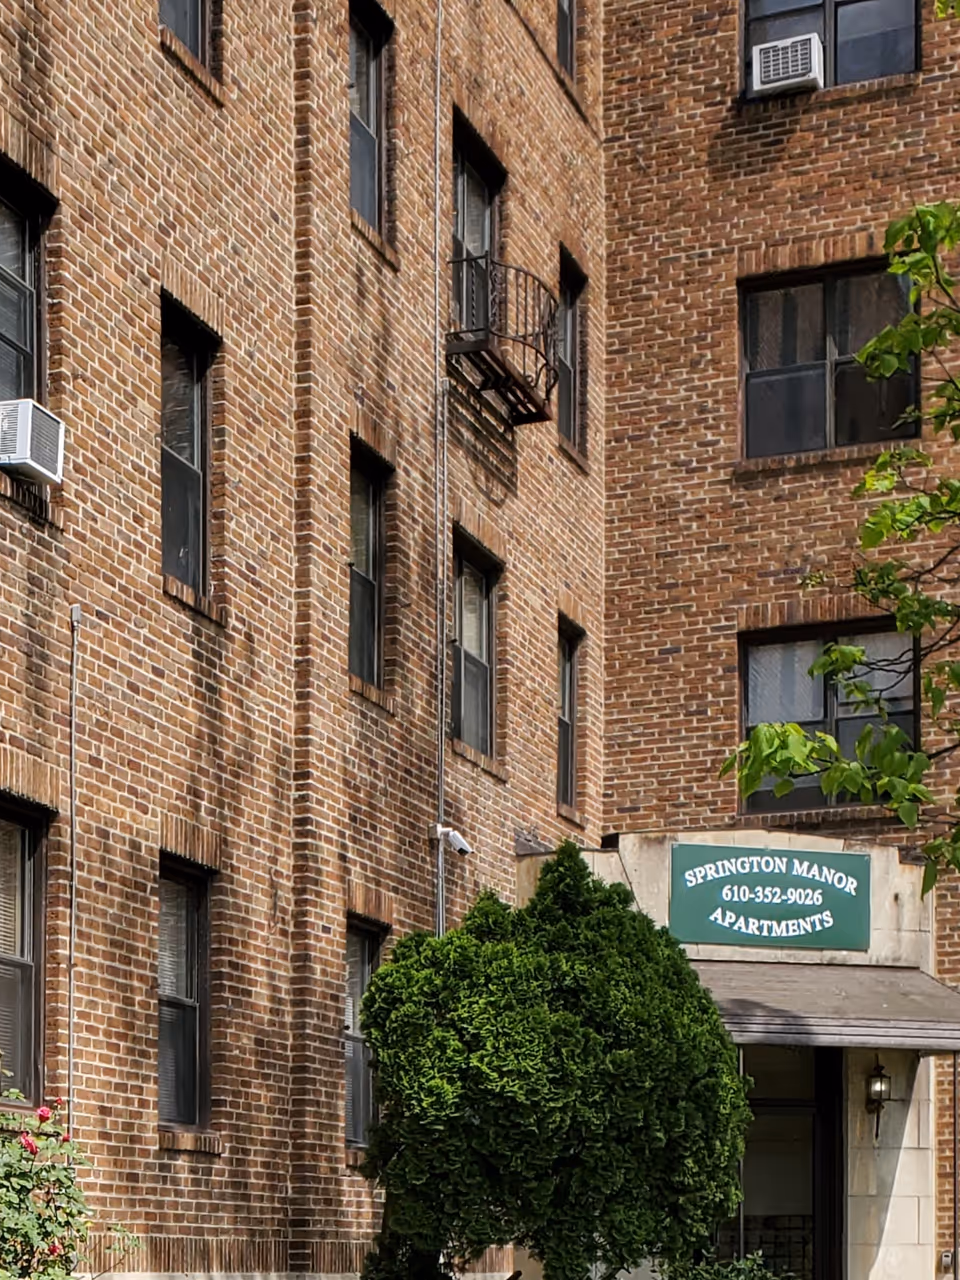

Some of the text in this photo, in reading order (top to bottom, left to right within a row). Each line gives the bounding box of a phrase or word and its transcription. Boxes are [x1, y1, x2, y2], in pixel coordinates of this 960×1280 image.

[684, 856, 858, 896] SPRINGTON MANOR
[722, 885, 823, 905] 610-352-9026
[709, 907, 834, 937] APARTMENTS
